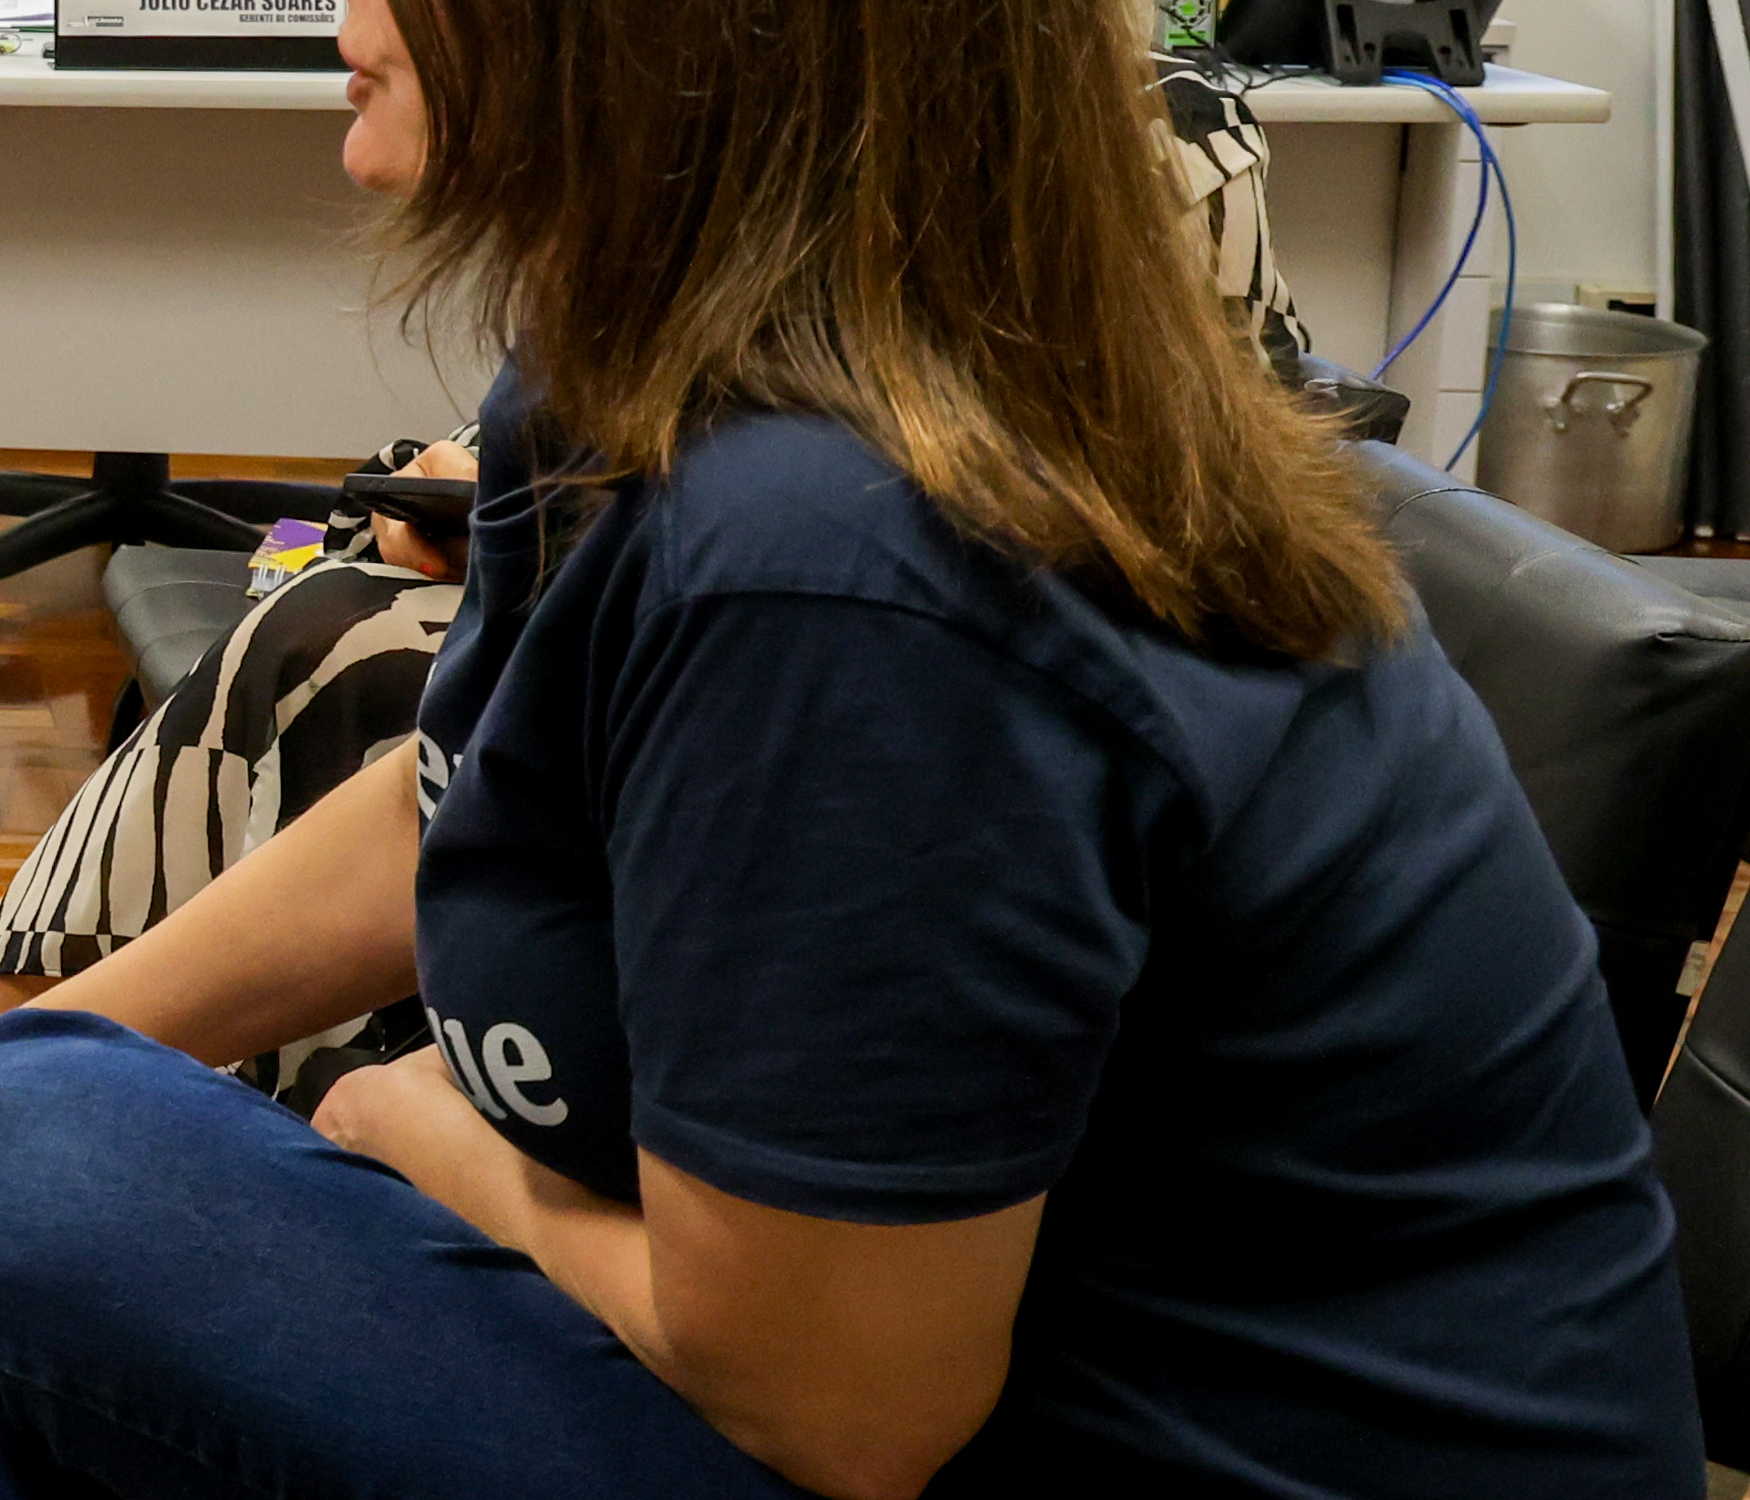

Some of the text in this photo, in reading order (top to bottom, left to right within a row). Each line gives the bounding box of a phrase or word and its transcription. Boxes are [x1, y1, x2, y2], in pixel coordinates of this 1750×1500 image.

[239, 13, 335, 23] GERENTE DE COMISSÕES
[426, 1006, 569, 1127] ue
